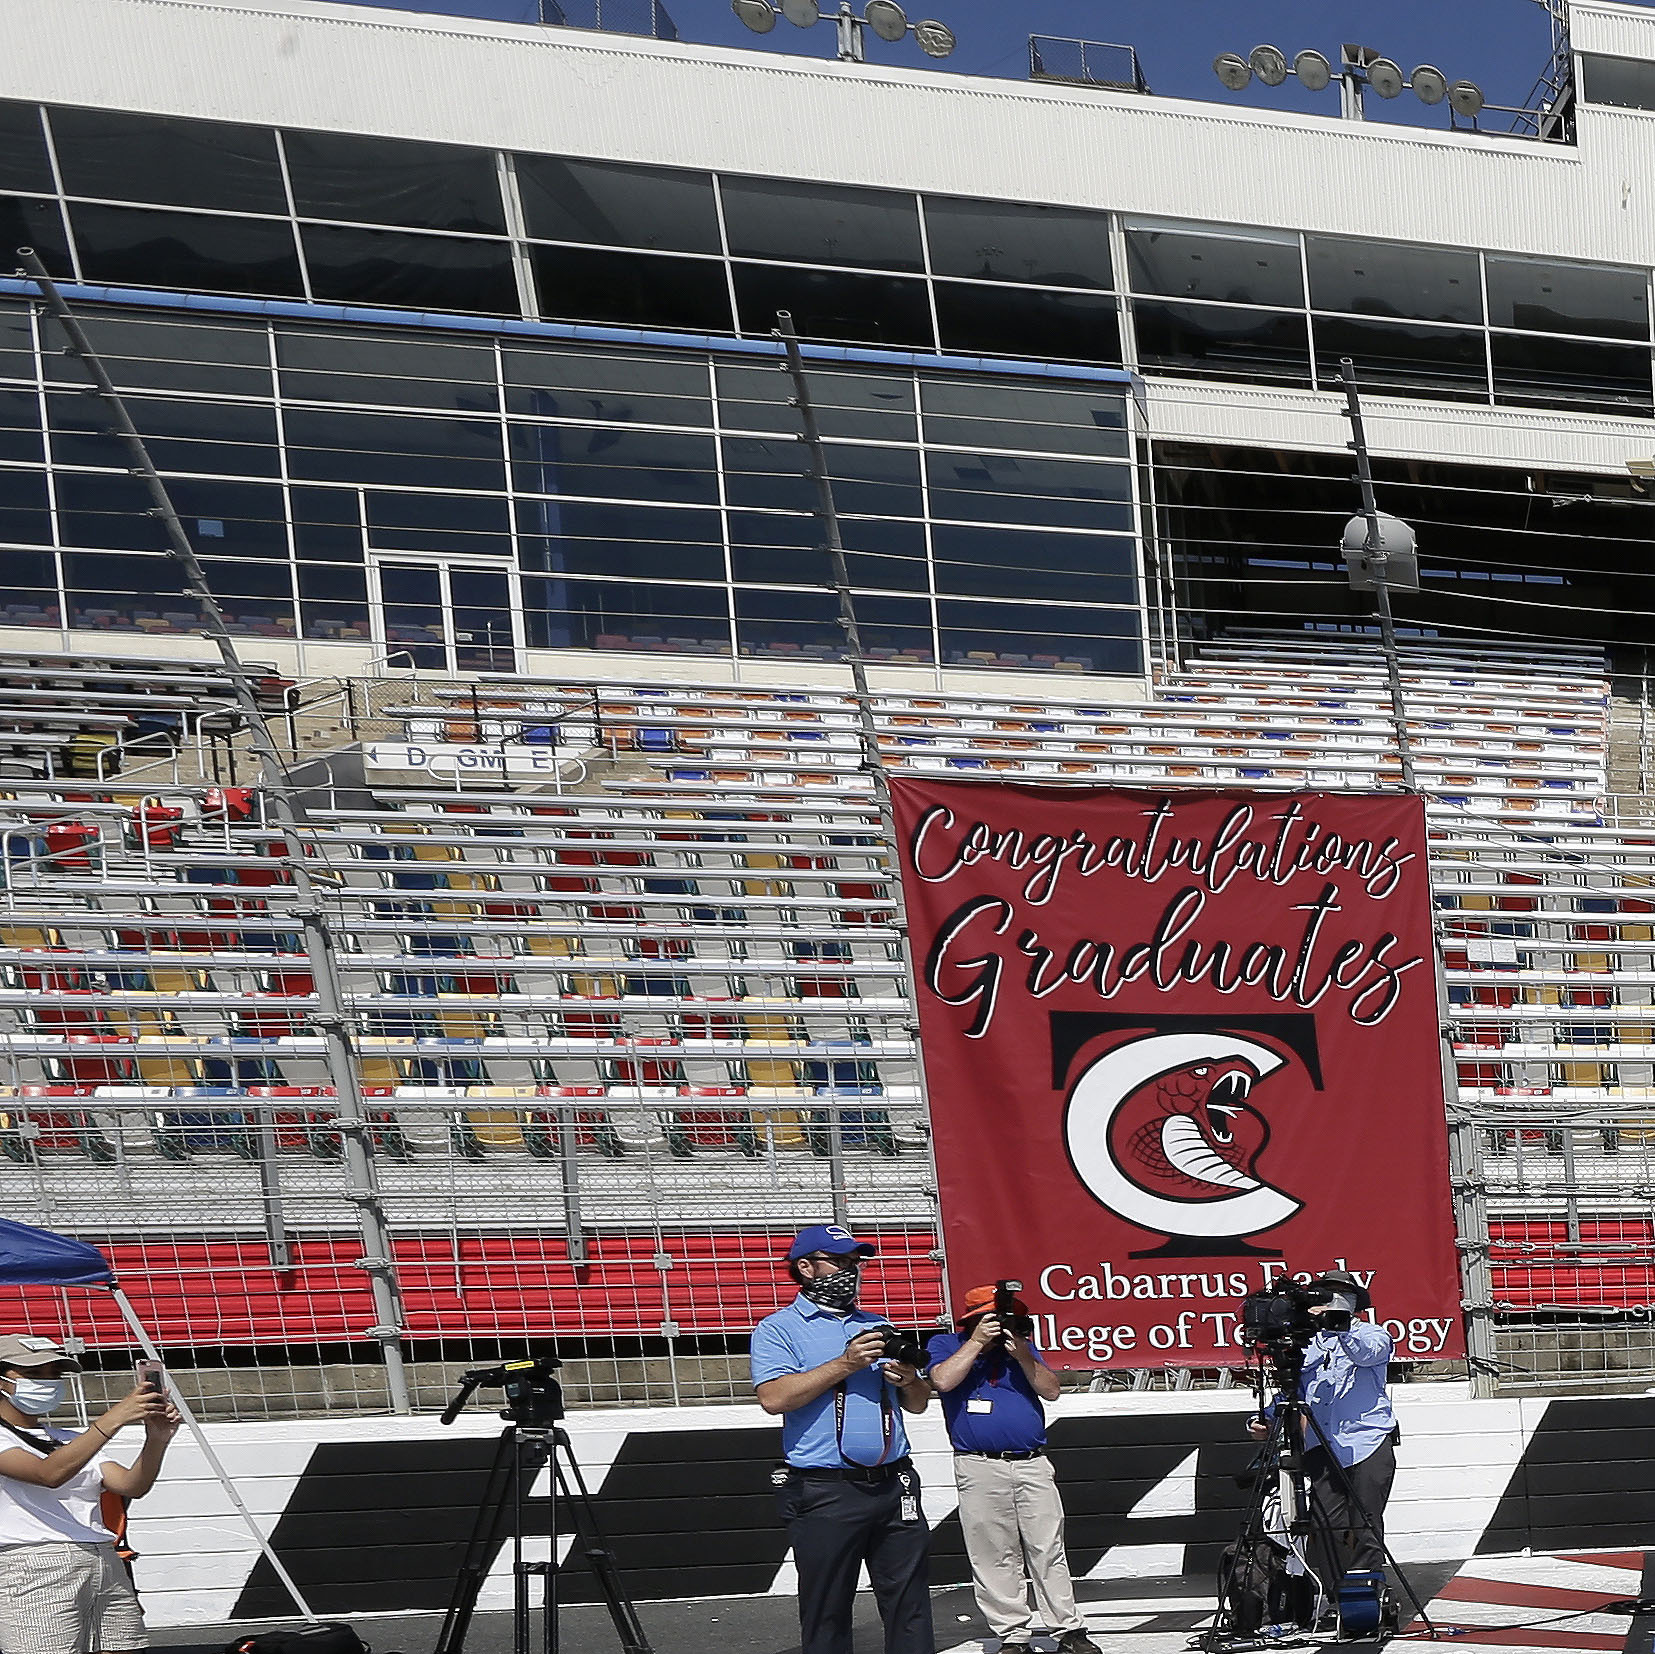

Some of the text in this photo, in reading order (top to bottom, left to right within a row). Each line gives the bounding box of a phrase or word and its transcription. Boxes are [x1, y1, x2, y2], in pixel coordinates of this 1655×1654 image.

[406, 747, 427, 767] D
[911, 798, 1416, 908] Congratulations
[924, 883, 1424, 1039] Graduates
[1039, 1261, 1248, 1302] Cabarrus
[1148, 1311, 1196, 1349] of
